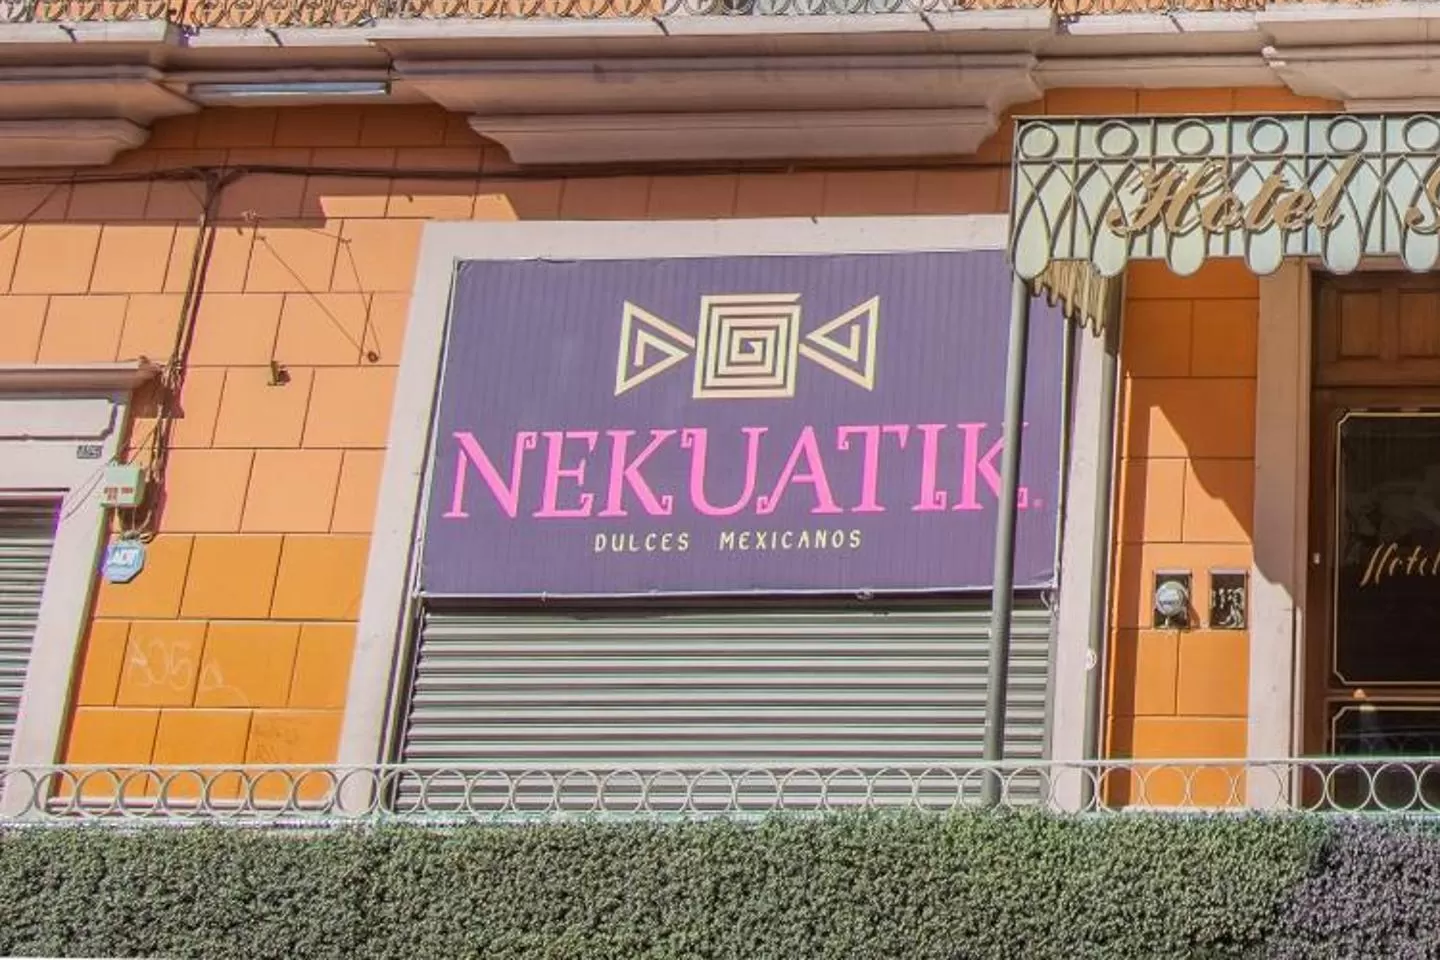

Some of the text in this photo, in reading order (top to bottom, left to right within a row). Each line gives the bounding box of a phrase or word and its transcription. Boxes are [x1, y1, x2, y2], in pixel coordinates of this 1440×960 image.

[1105, 152, 1367, 238] Hotel
[594, 529, 862, 553] DULCES MEXICANOS
